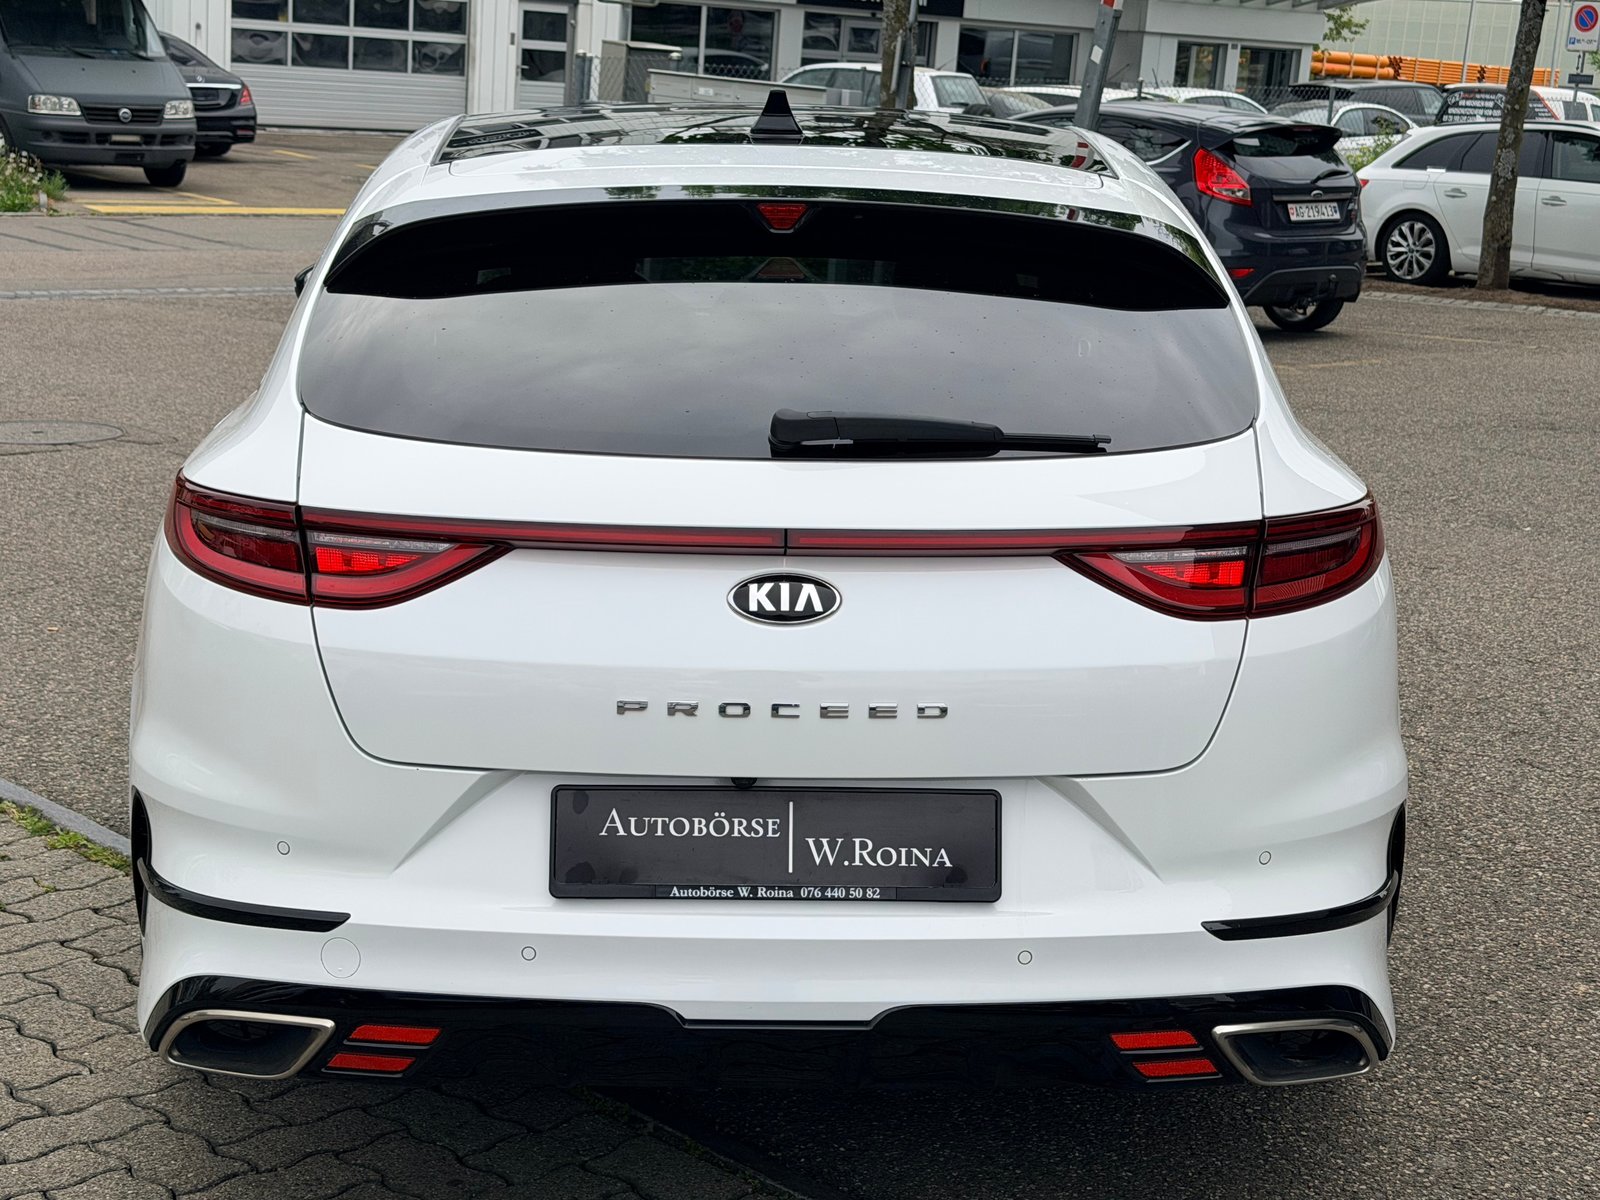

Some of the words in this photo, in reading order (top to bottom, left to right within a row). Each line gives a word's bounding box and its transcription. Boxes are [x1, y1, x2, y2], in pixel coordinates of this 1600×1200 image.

[747, 582, 824, 613] KIA
[616, 699, 949, 719] PROCEED
[669, 886, 735, 899] Autobörse
[737, 887, 754, 899] W.
[757, 886, 794, 899] Roina
[800, 887, 822, 899] 076
[824, 887, 846, 900] 440
[848, 887, 865, 900] 50
[866, 887, 881, 900] 82
